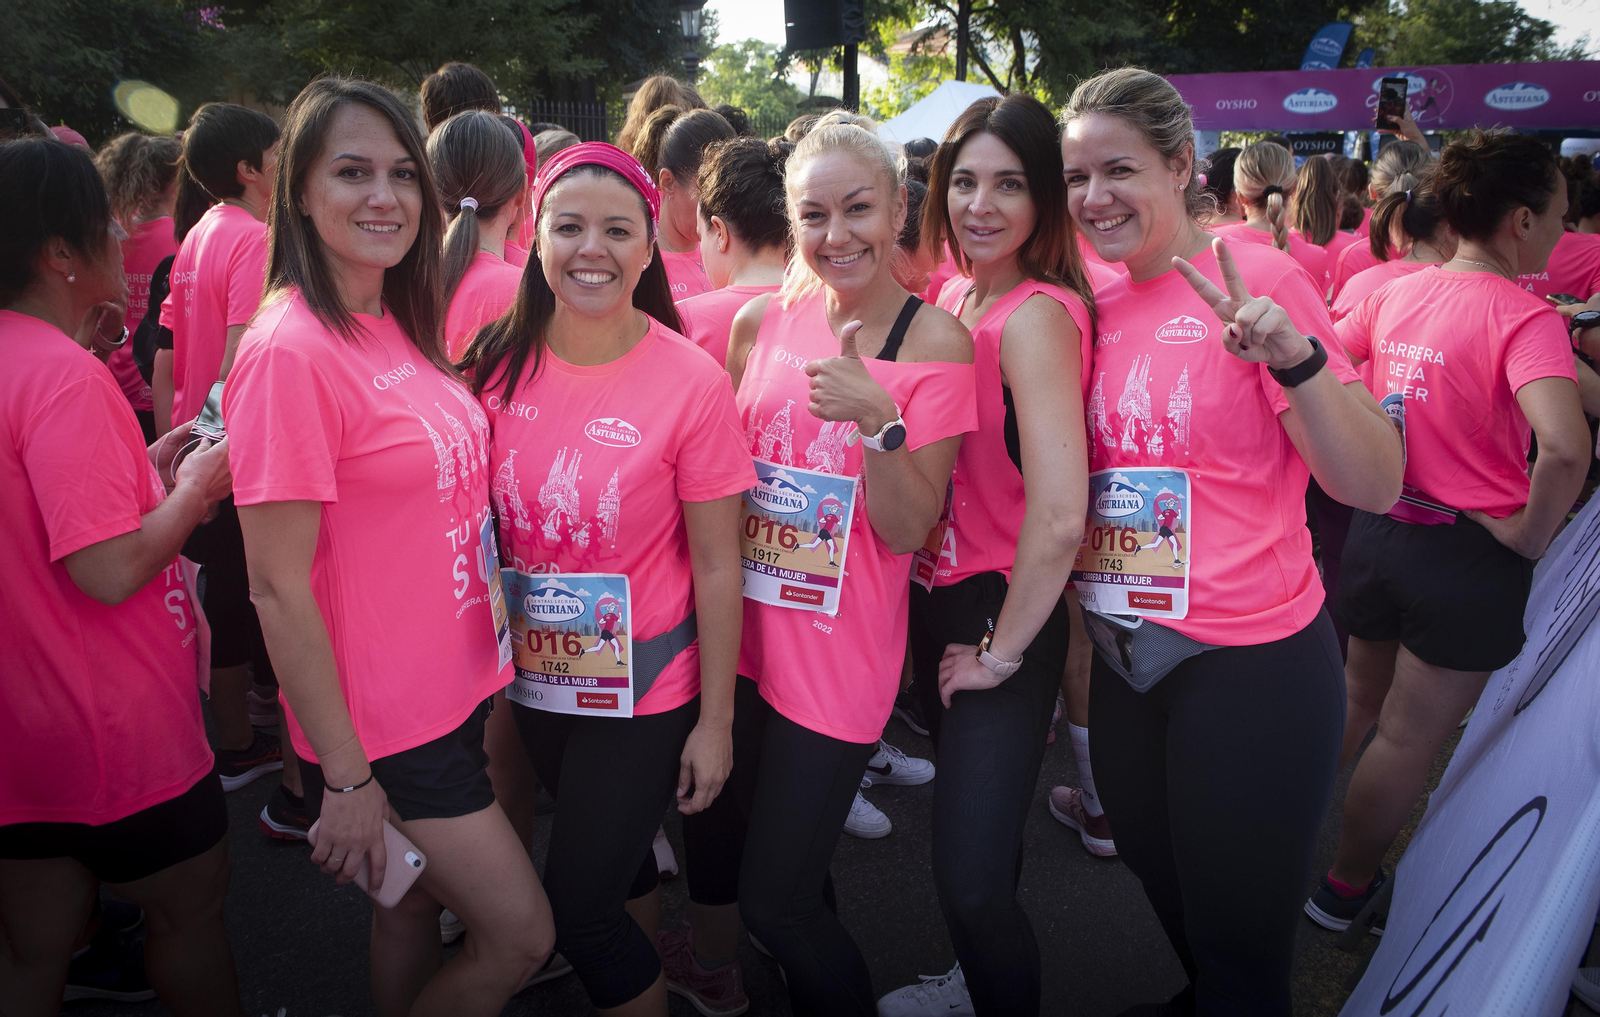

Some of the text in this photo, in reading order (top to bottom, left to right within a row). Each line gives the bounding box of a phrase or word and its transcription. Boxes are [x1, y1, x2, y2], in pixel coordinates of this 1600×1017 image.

[1215, 98, 1258, 110] OYSHO
[1286, 97, 1334, 108] ASTURIANA
[1489, 93, 1546, 104] ASTURIANA
[1293, 140, 1336, 151] OYSHO
[1158, 327, 1203, 338] ASTURIANA
[1379, 340, 1445, 366] CARRERA
[373, 362, 417, 390] OYSHO
[1390, 361, 1426, 382] DE LA
[588, 424, 636, 444] ASTURIANA
[751, 486, 804, 510] ASTURIANA
[1096, 496, 1140, 510] ASTURIANA
[446, 520, 470, 552] TU
[745, 514, 798, 549] 016
[1092, 526, 1138, 552] 016
[752, 547, 780, 564] 1917
[1099, 558, 1123, 571] 1743
[756, 564, 766, 572] DE
[768, 566, 777, 576] LA
[779, 569, 807, 582] MUJER
[1082, 572, 1152, 586] CARRERA DE LA MUJER
[792, 592, 818, 600] Santander
[1140, 597, 1166, 605] Santander
[456, 596, 481, 619] CARRERA
[526, 600, 581, 614] ASTURIANA
[812, 620, 832, 634] 2022
[528, 630, 582, 656] 016
[541, 660, 570, 674] 1742
[522, 670, 598, 686] CARRERA DE LA MUJER
[514, 683, 544, 702] OYSHO
